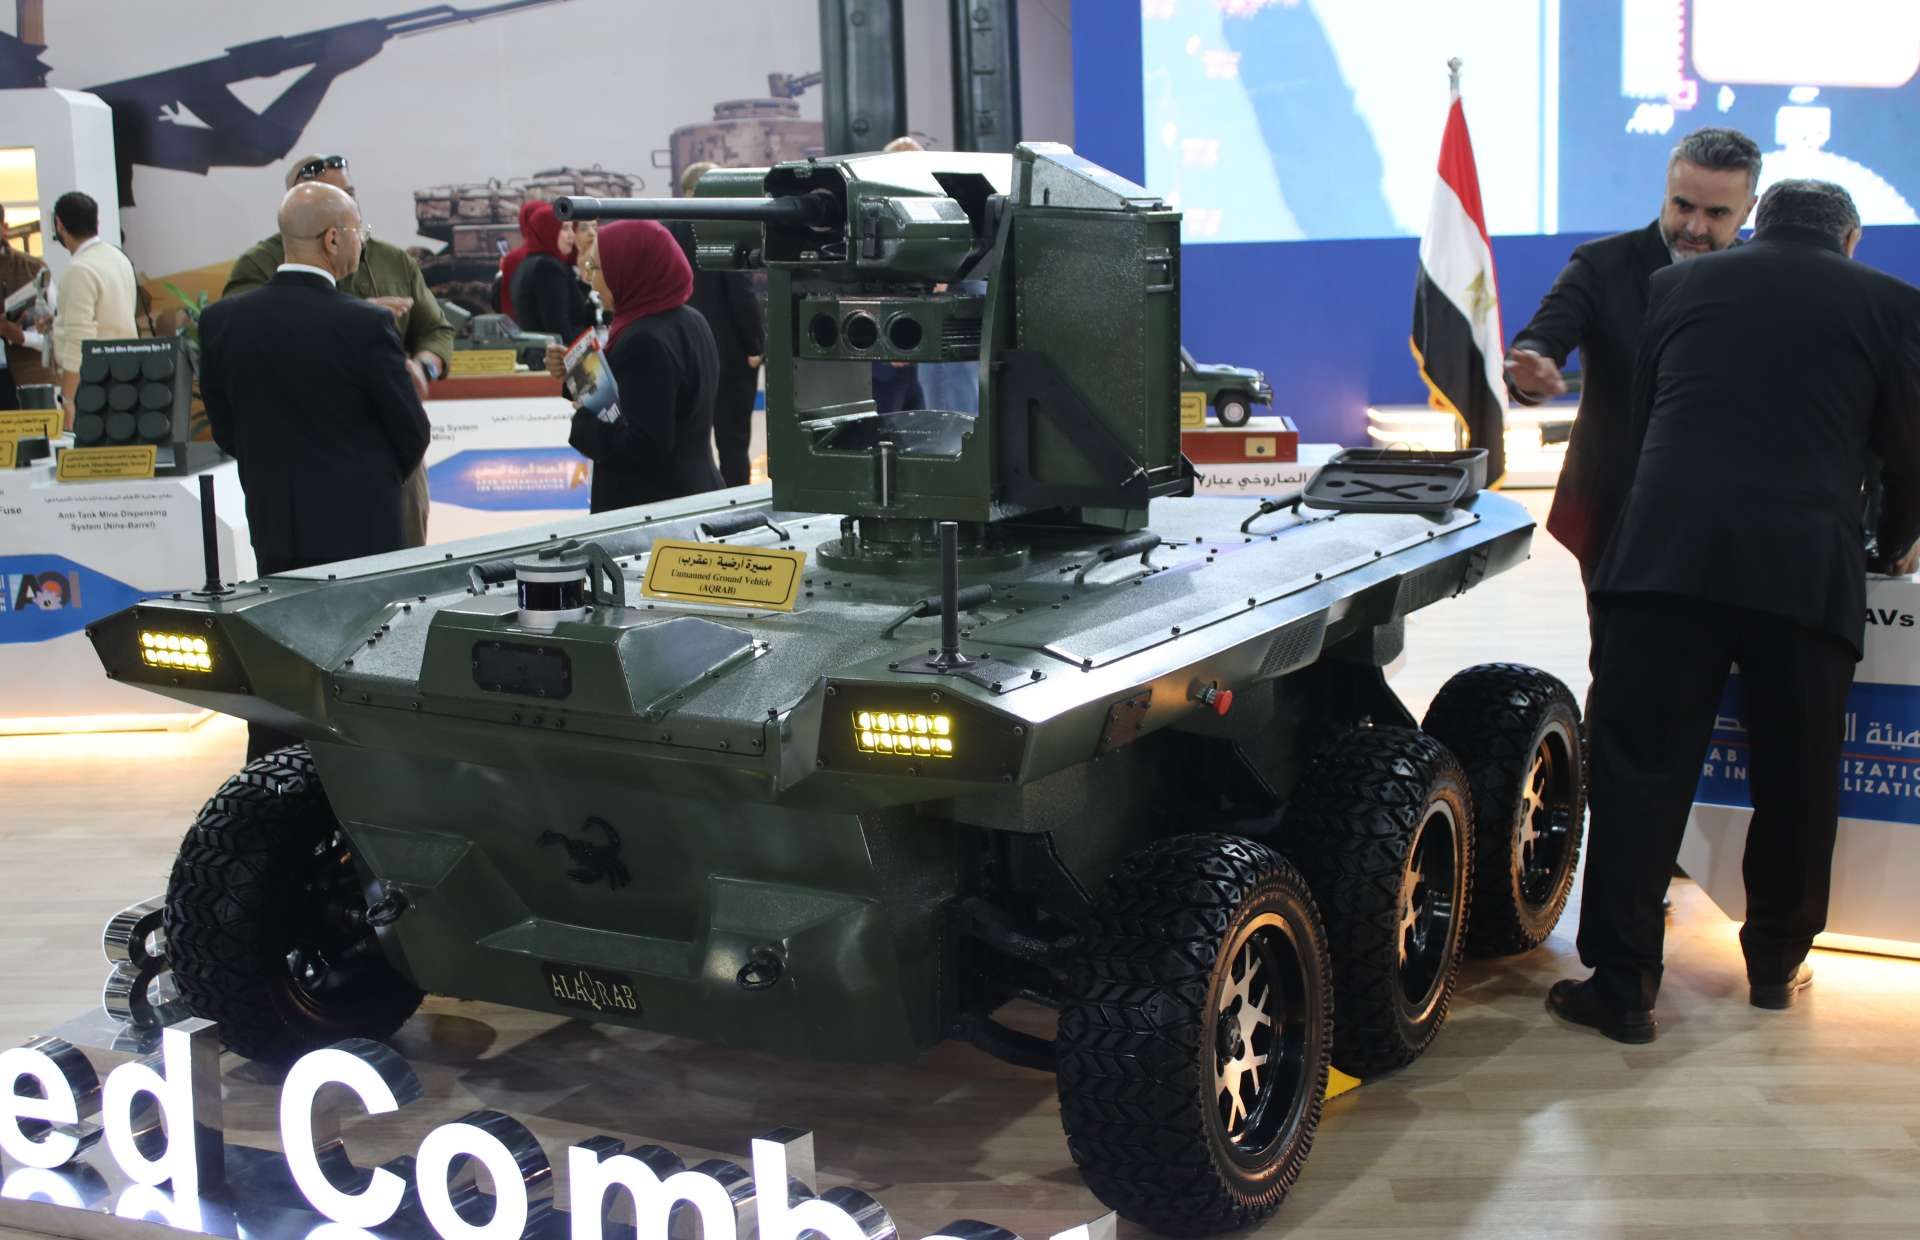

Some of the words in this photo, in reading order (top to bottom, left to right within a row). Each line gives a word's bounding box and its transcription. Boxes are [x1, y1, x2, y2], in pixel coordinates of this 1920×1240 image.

[1238, 472, 1307, 490] الصاروخي
[71, 523, 102, 532] System
[678, 553, 713, 567] (عقرب)
[717, 555, 745, 571] أرضية
[745, 558, 773, 573] مسيرة
[671, 568, 711, 581] Unmanned
[713, 573, 742, 584] Ground
[745, 576, 773, 587] Vehicle
[699, 583, 737, 595] (AQRAB)
[551, 970, 638, 1012] ALAQRAB
[281, 1048, 1092, 1240] Comb
